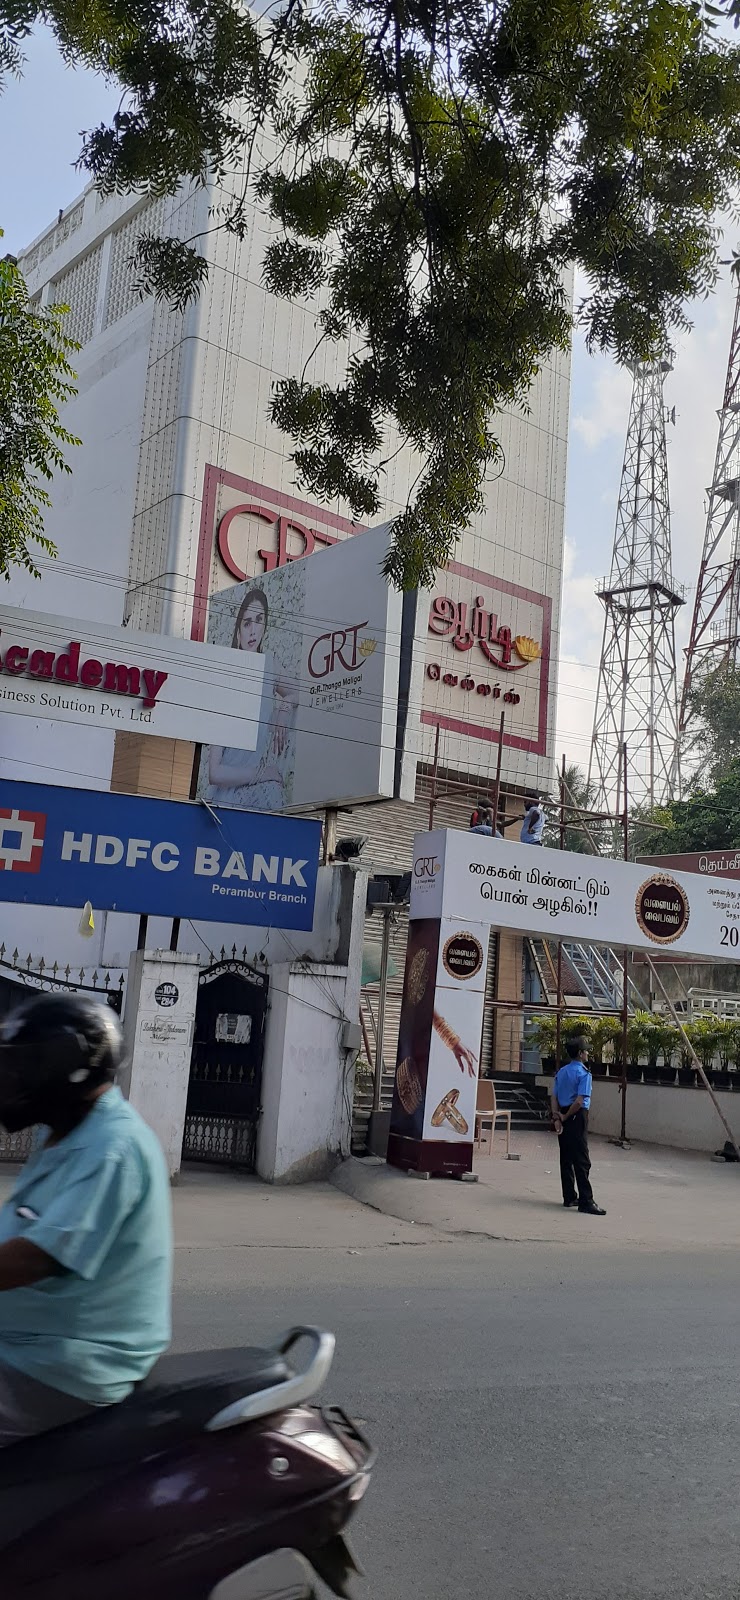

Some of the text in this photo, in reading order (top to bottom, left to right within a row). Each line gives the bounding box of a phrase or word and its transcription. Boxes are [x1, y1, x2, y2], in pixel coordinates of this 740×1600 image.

[218, 503, 343, 582] GR
[307, 620, 369, 678] GRT
[0, 641, 169, 708] cademy
[40, 693, 95, 714] Solution
[100, 703, 125, 719] Pvt.
[130, 708, 155, 724] Ltd.
[309, 686, 362, 708] JEWELLERS
[61, 831, 309, 888] HDFC BANK
[414, 856, 438, 877] GRT
[212, 884, 307, 904] Perambur Branch
[469, 862, 610, 899] கைகள் மின்னட்டும்
[480, 881, 598, 917] பொன் அழகில்!!
[643, 899, 681, 912] வளையல்
[720, 925, 740, 947] 20
[163, 985, 176, 995] 104
